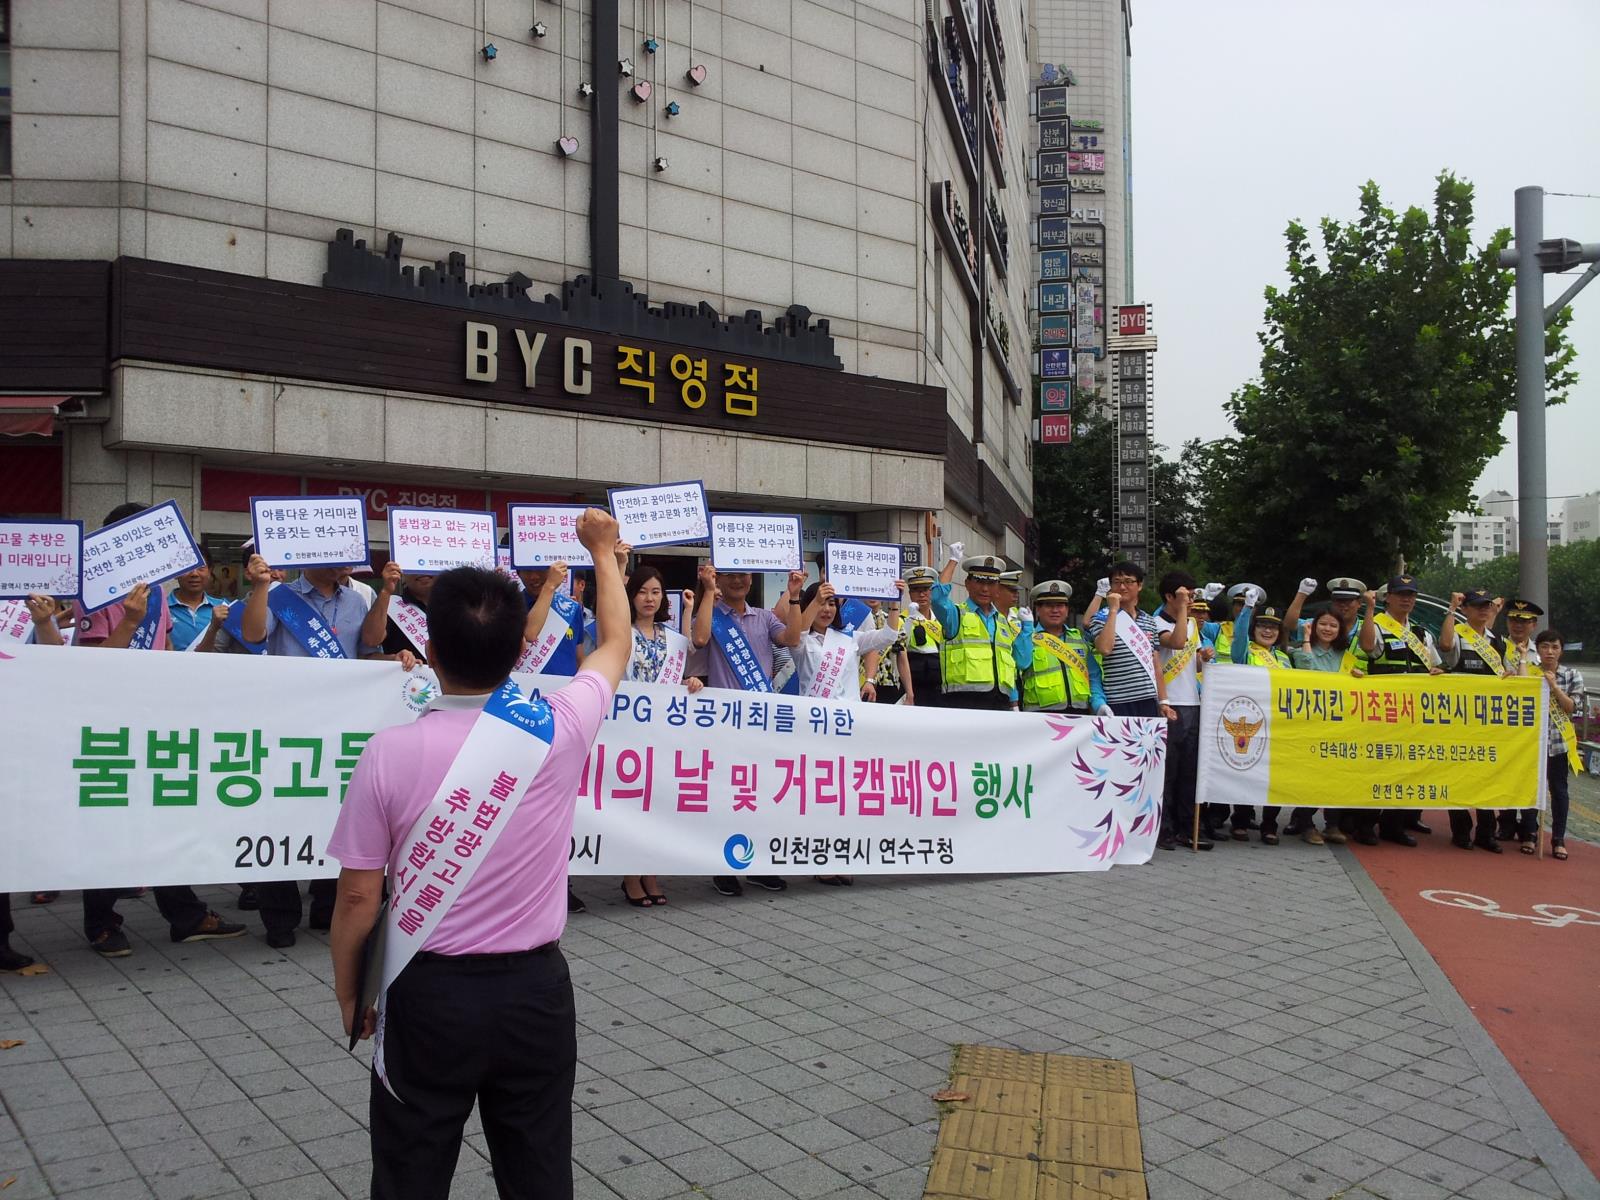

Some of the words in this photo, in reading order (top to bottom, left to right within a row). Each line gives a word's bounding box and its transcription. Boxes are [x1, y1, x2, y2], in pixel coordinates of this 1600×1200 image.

[1044, 163, 1065, 174] 치과
[1071, 207, 1103, 223] 치과
[1043, 230, 1067, 240] 피부과
[1043, 293, 1066, 305] 내과
[1120, 313, 1145, 328] BYC
[465, 320, 593, 396] BYC
[617, 345, 758, 417] 직영점
[1046, 388, 1066, 408] 약
[1045, 424, 1067, 437] BYC
[616, 493, 649, 510] 안전하고
[650, 491, 682, 507] 꿈이있는
[683, 489, 699, 503] 연수
[261, 507, 309, 522] 아름다운
[313, 506, 358, 520] 거리미관
[517, 514, 556, 526] 불법광고
[559, 514, 578, 526] 없는
[623, 510, 649, 525] 건전한
[649, 506, 681, 523] 광고문화
[682, 505, 698, 518] 정착
[264, 526, 311, 540] 웃음짓는
[314, 524, 359, 538] 연수구민
[398, 518, 442, 530] 불법광고
[445, 519, 466, 532] 없는
[470, 521, 490, 533] 거리
[716, 522, 754, 534] 아름다운
[757, 523, 794, 535] 거리미관
[27, 533, 66, 547] 추방은
[83, 540, 110, 562] 전하고
[112, 523, 153, 549] 꿈이있는
[153, 514, 175, 527] 연수
[398, 535, 443, 547] 찾아오는
[446, 536, 467, 548] 연수
[471, 538, 491, 550] 손님
[517, 531, 557, 542] 찾아오는
[560, 531, 579, 542] 연수
[717, 536, 754, 549] 웃음짓는
[758, 537, 795, 549] 연수구민
[1121, 533, 1145, 543] 피부과
[8, 553, 72, 567] 미래입니다
[83, 561, 114, 581] 건전한
[115, 542, 156, 567] 광고문화
[156, 532, 179, 549] 정착
[295, 551, 322, 560] 인천광역시
[323, 550, 344, 558] 연수구청
[742, 557, 763, 565] 인천광역시
[831, 550, 864, 561] 아름다운
[866, 552, 896, 564] 거리미관
[902, 551, 918, 562] 103
[149, 562, 173, 576] 연수구청
[832, 563, 864, 576] 웃음짓는
[866, 566, 896, 578] 연수구민
[23, 581, 50, 590] 연수구청
[809, 651, 833, 697] 추방합시
[1277, 687, 1344, 721] 내가지킨
[1350, 689, 1415, 724] 기초질서
[1420, 692, 1468, 725] 인천시
[1474, 695, 1536, 727] 대표얼굴
[602, 694, 652, 723] PG
[666, 697, 796, 732] 성공개최를
[808, 705, 854, 736] 위한
[1408, 744, 1448, 762] 음주소란,
[1450, 745, 1487, 762] 인근소란
[1488, 746, 1497, 762] 등
[674, 749, 714, 813] 날
[731, 763, 758, 813] 및
[772, 754, 958, 817] 거리캠페인
[971, 762, 1034, 819] 행사
[1372, 784, 1449, 801] 인천연수경찰서
[234, 835, 325, 868] 2014.
[567, 834, 603, 865] 시
[769, 837, 871, 865] 인천광역시
[879, 838, 955, 865] 연수구청
[397, 770, 519, 937] 불법광고물을
